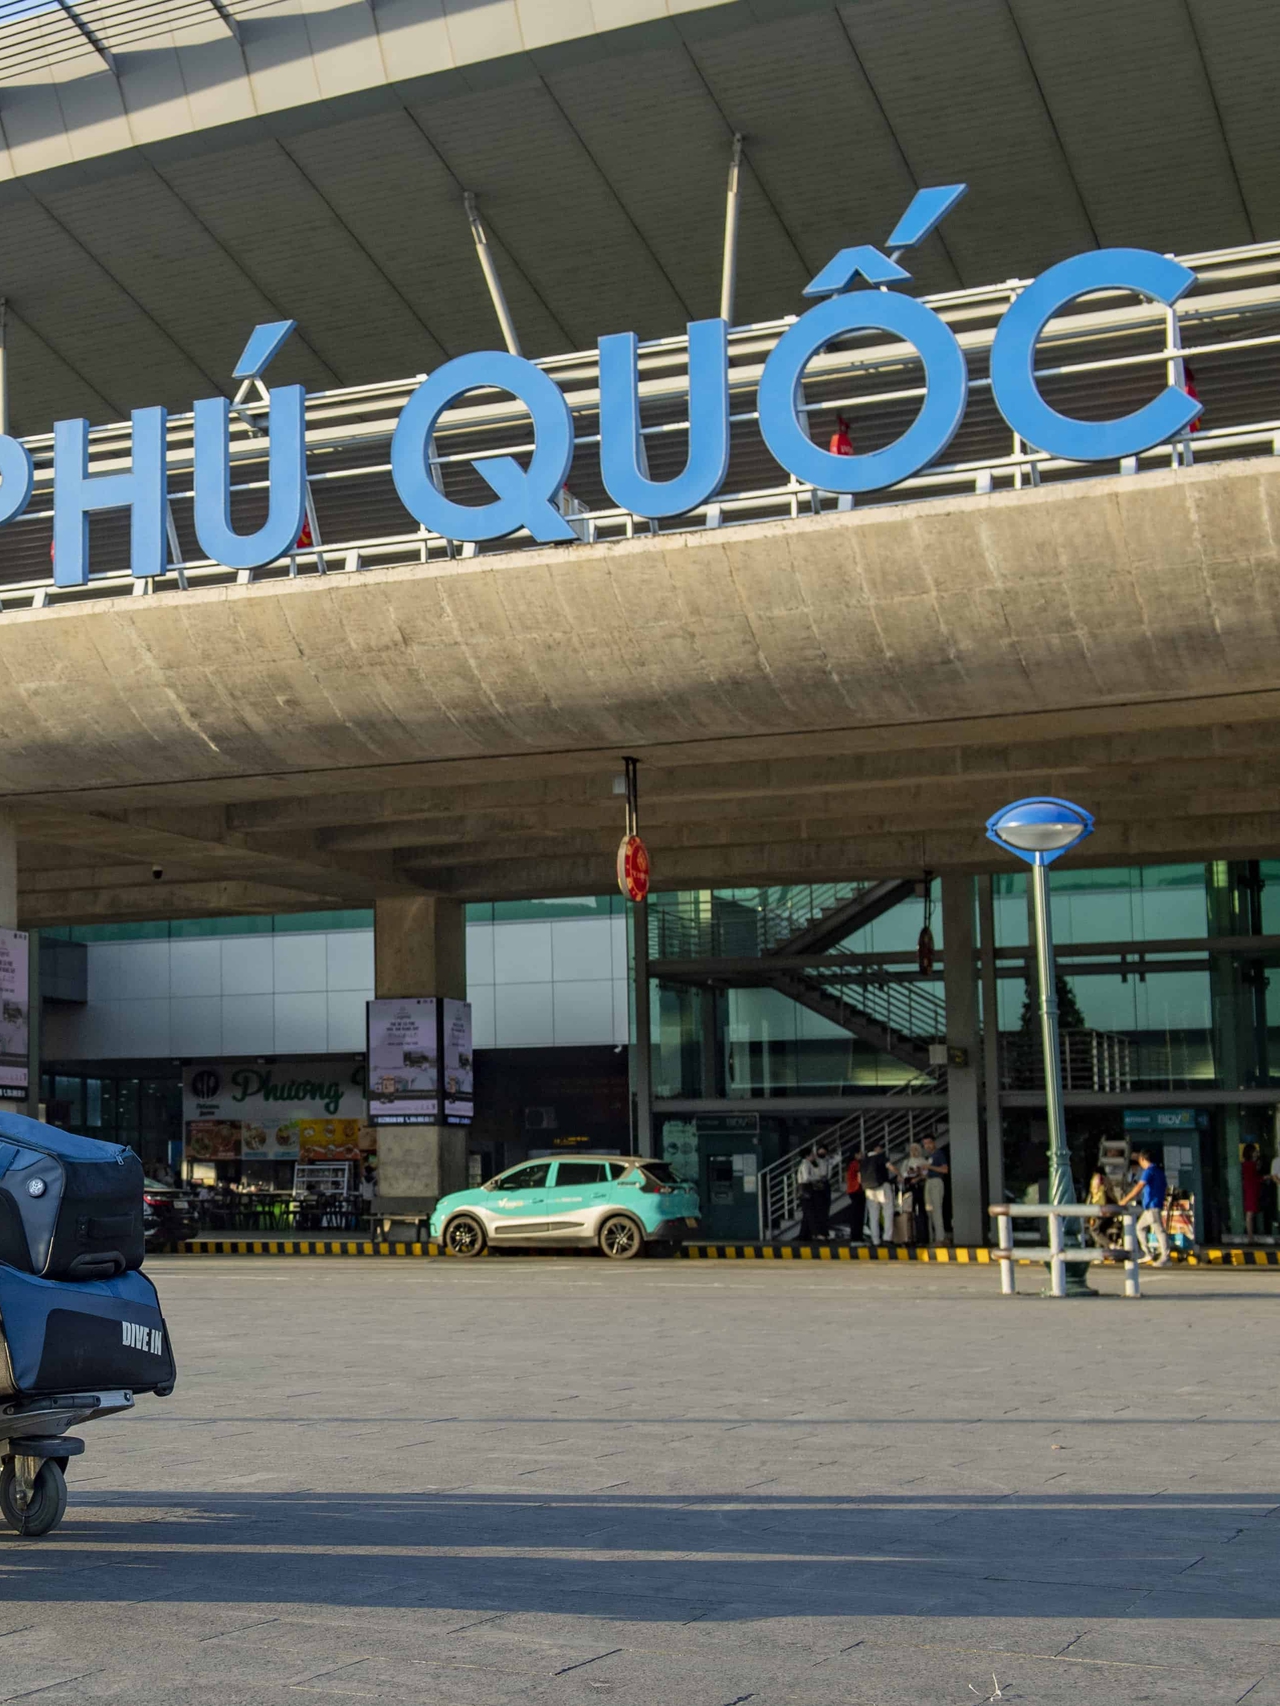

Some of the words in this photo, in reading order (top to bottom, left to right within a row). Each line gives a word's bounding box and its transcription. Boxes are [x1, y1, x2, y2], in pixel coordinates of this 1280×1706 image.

[391, 183, 1204, 545] QUỐC
[122, 1320, 150, 1352] DIVE
[150, 1328, 162, 1356] IN
